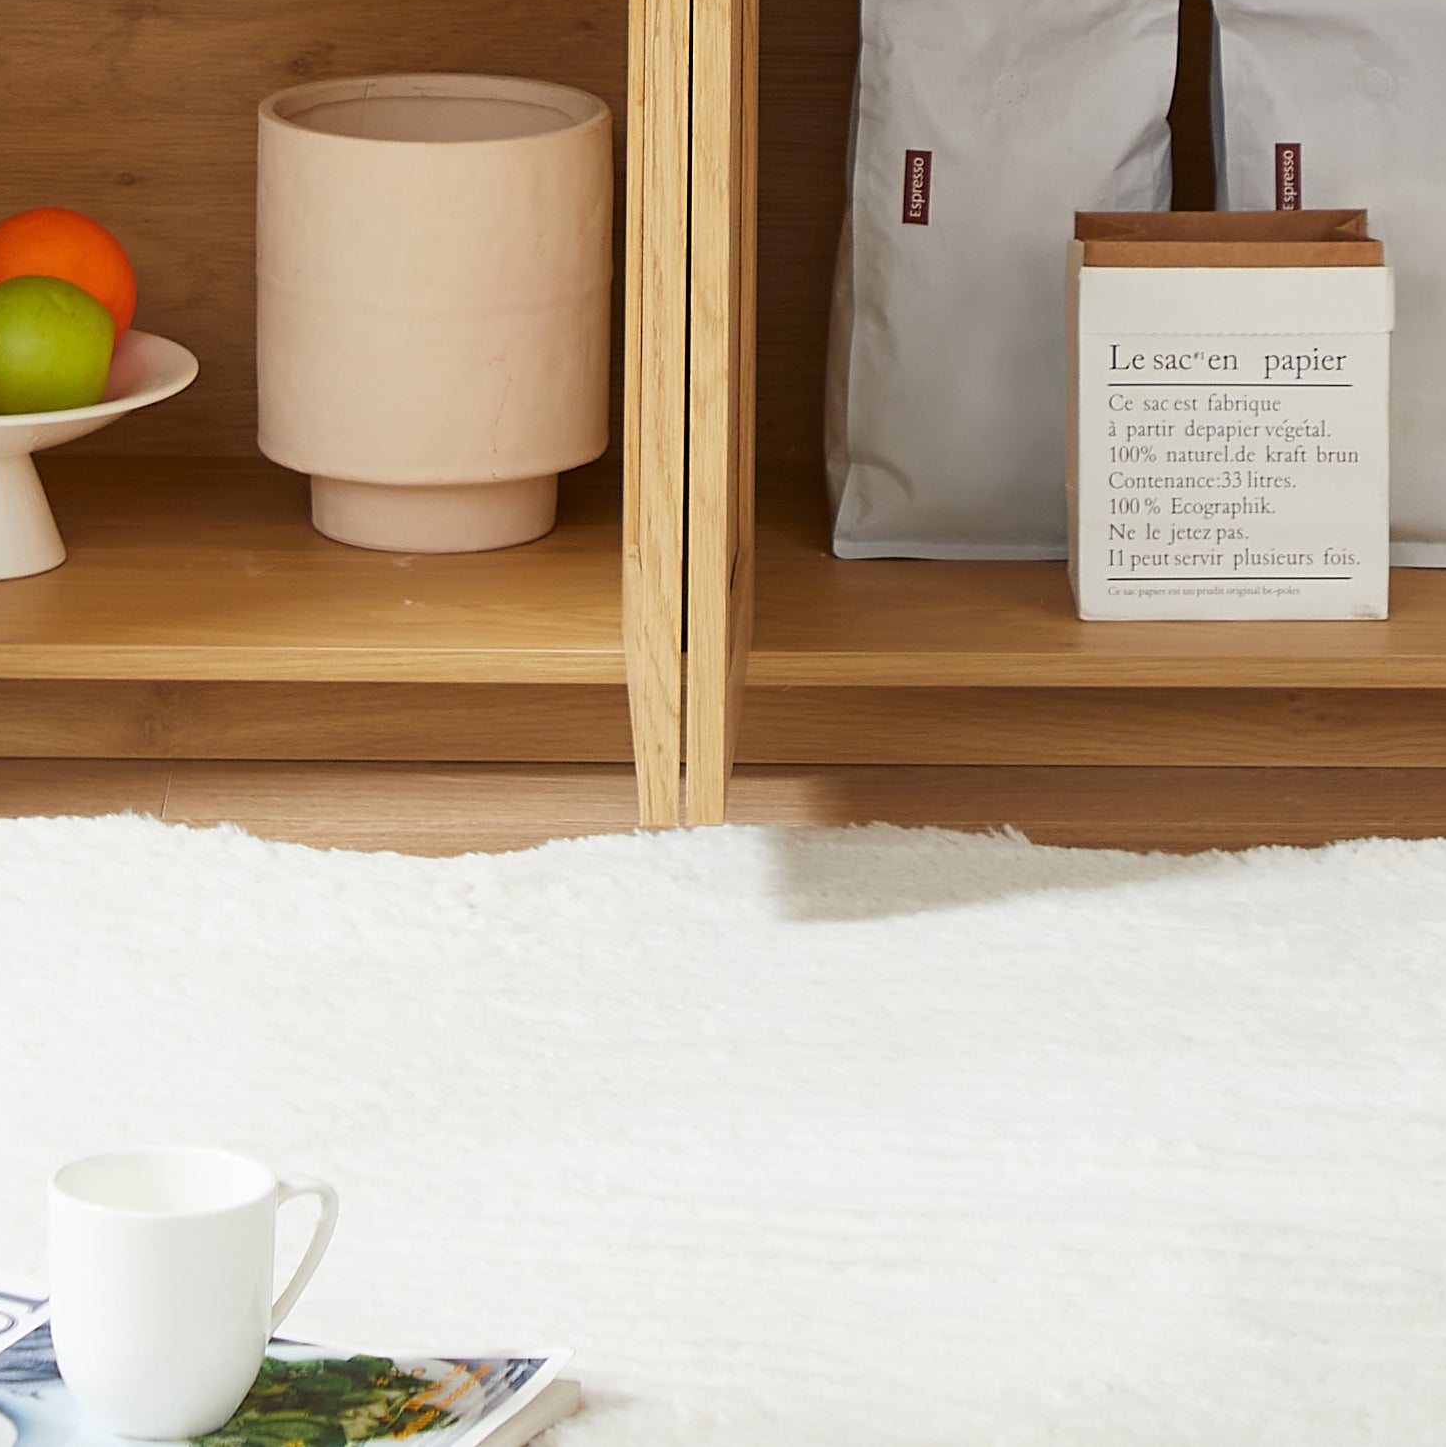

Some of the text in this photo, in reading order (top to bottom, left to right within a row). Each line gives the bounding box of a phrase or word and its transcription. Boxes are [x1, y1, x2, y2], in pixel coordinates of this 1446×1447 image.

[909, 157, 926, 217] Espresso
[1282, 150, 1298, 211] Espresso
[1108, 344, 1145, 370] Le
[1153, 353, 1191, 370] sac
[1208, 354, 1238, 370] en
[1264, 348, 1347, 380] papier
[1109, 394, 1281, 417] Ce sac est fabrique
[1108, 421, 1117, 437] à
[1126, 420, 1175, 442] partir
[1110, 445, 1157, 463] 100%
[1265, 445, 1308, 463] kraft
[1316, 445, 1359, 463] brun
[1247, 471, 1297, 489] litres.
[1171, 496, 1276, 520] Ecographik.
[1108, 523, 1249, 545] Ne le jetez pas.
[1130, 553, 1170, 571] peut
[1174, 548, 1223, 566] servir
[1233, 548, 1314, 571] plusieurs
[1323, 548, 1361, 566] fois.
